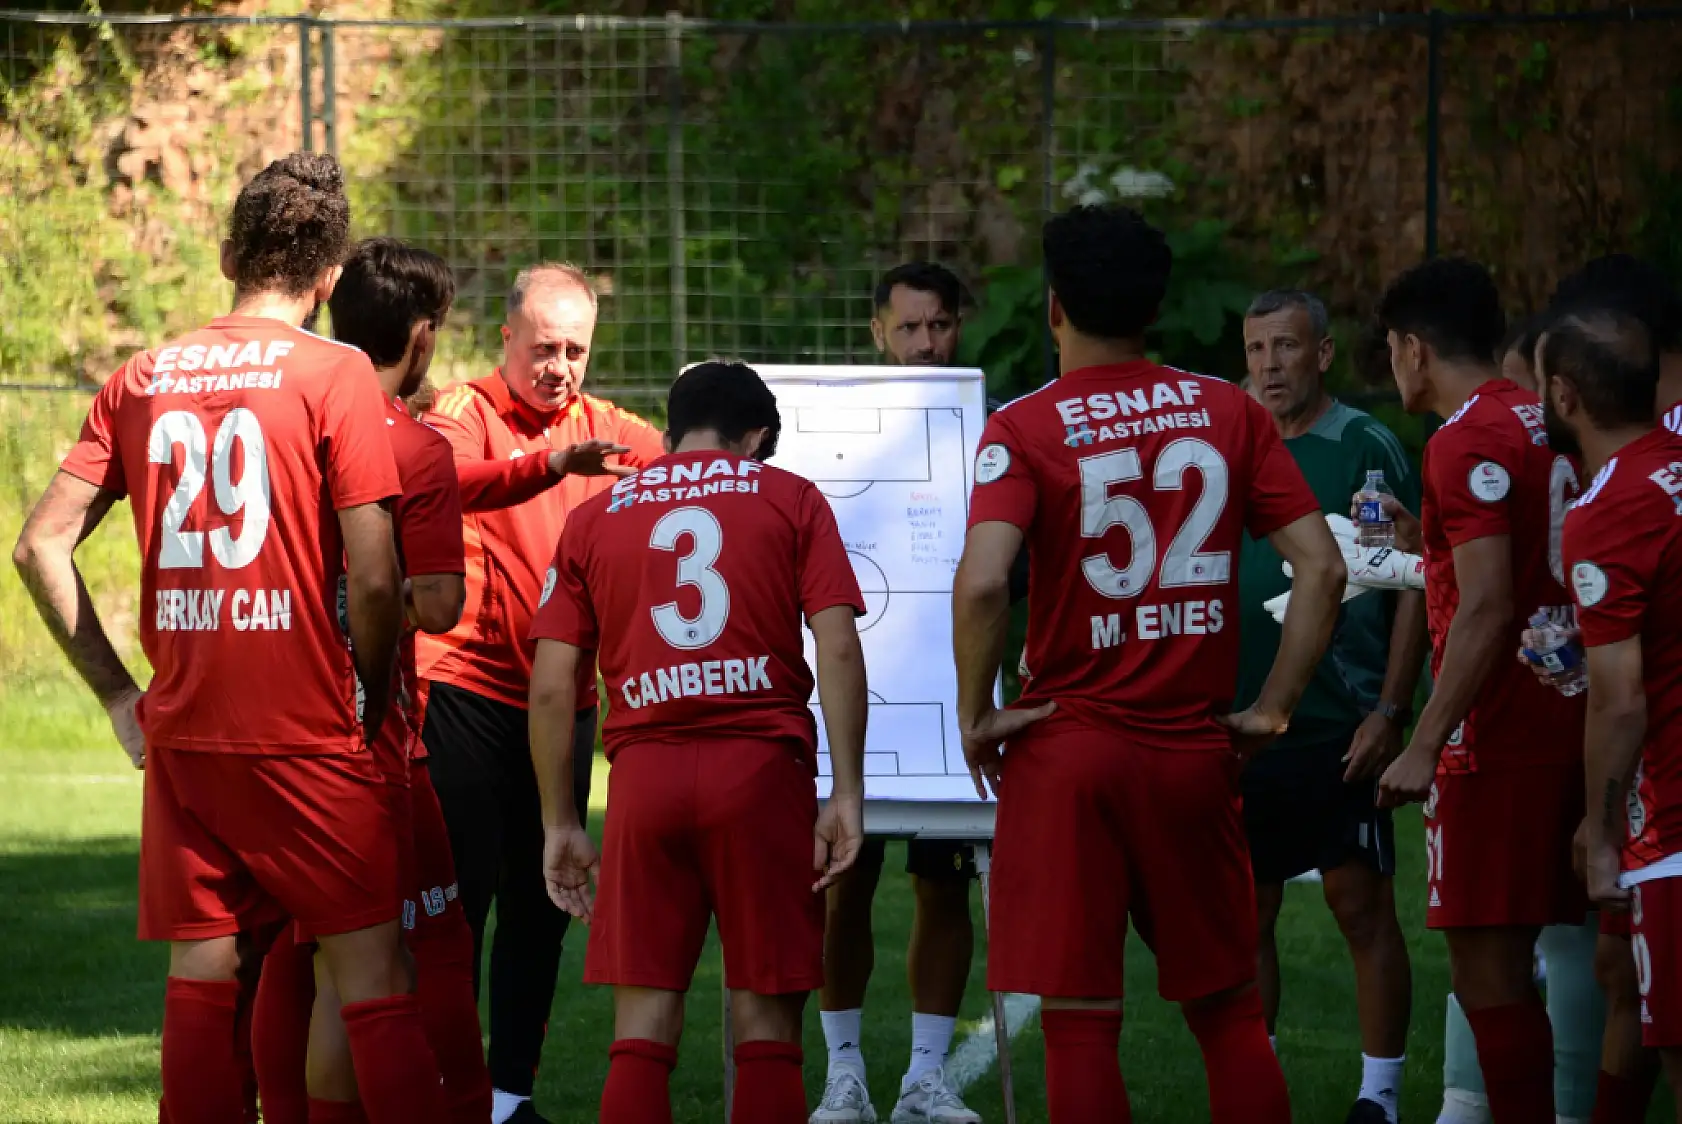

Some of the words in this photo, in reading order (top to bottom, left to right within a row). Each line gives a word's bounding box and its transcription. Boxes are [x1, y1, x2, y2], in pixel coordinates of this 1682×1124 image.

[153, 340, 295, 373] ESNAF
[1055, 380, 1202, 425] ESNAF
[1064, 408, 1211, 447] HASTANESİ
[148, 407, 271, 569] 29
[611, 459, 764, 495] ESNAF
[1077, 437, 1231, 599] 52
[649, 505, 730, 650] 3
[231, 588, 292, 631] CAN
[1090, 613, 1126, 649] M.
[1136, 600, 1224, 640] ENES
[621, 656, 773, 709] CANBERK
